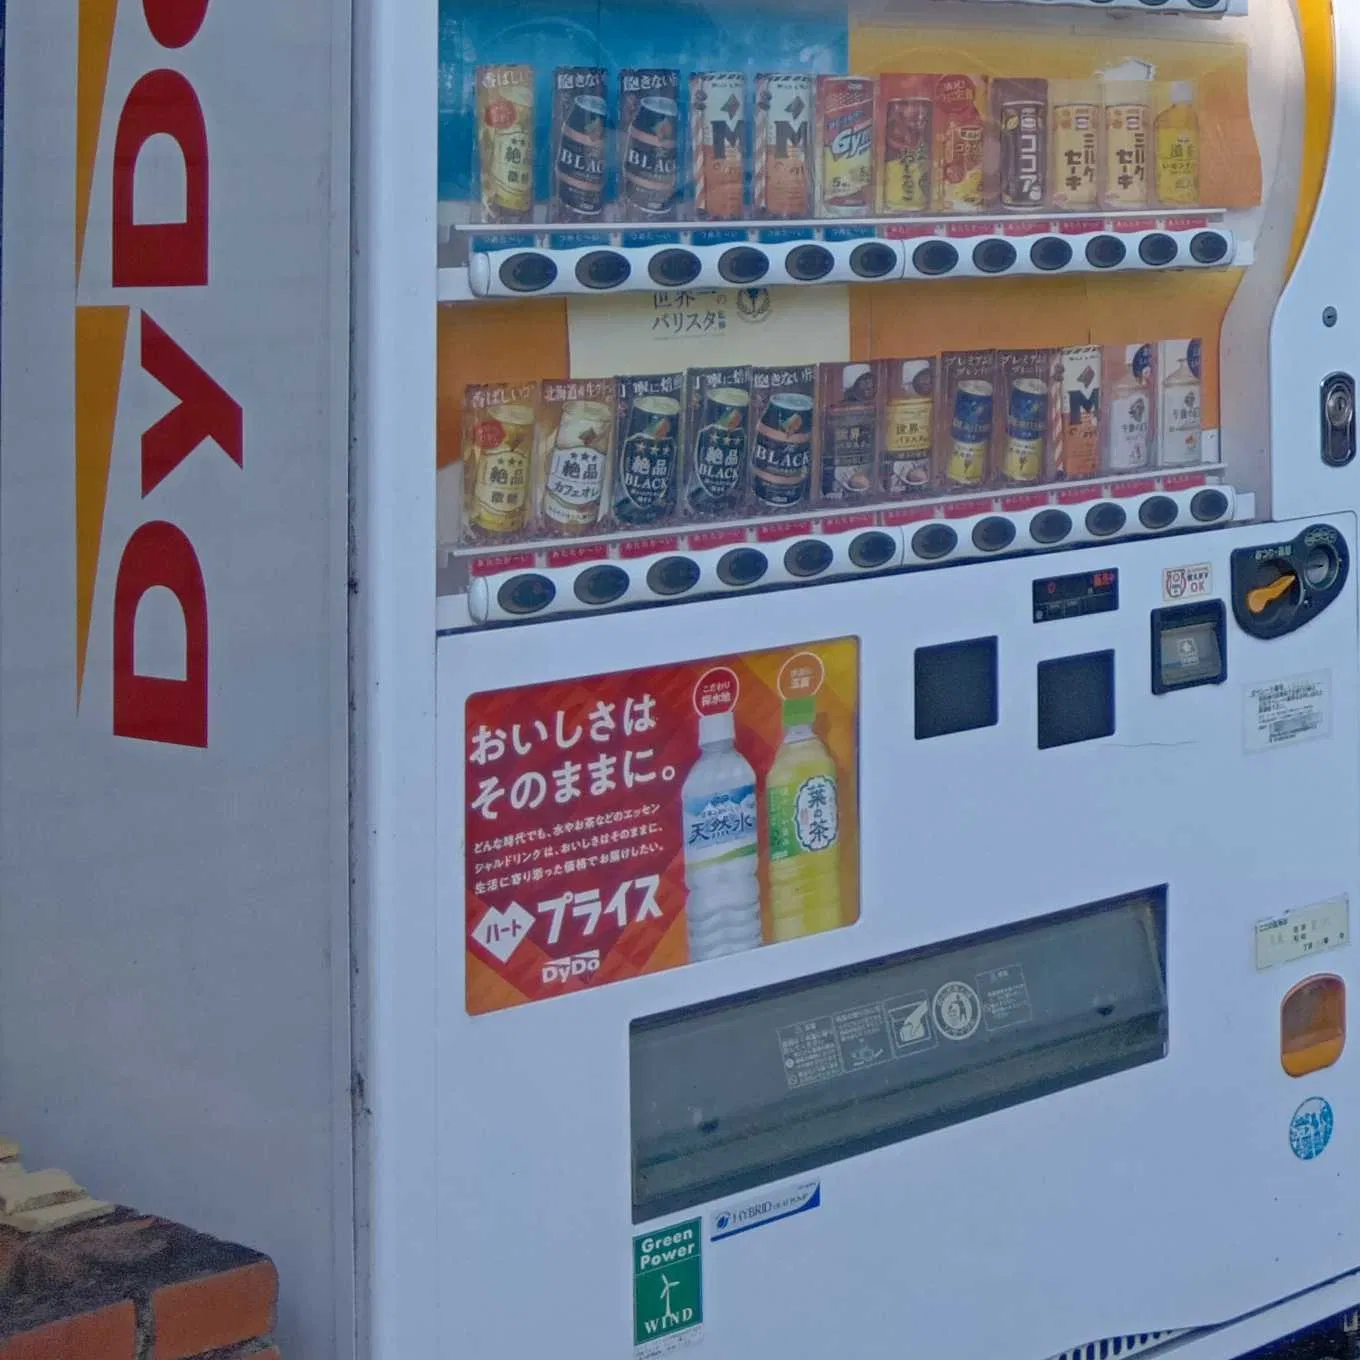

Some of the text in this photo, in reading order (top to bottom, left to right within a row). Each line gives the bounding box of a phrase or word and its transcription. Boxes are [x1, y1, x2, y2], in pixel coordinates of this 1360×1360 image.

[1020, 134, 1036, 192] ココア
[1084, 133, 1096, 183] ミルク
[1134, 132, 1145, 182] ミルク
[563, 461, 598, 480] 絶品
[624, 473, 668, 491] BLACK
[699, 463, 739, 480] BLACK
[470, 693, 658, 766] おいしさは
[471, 747, 676, 821] そのままに。
[688, 811, 754, 846] 天然水
[806, 784, 831, 843] 葉の茶
[538, 874, 664, 945] プライス
[486, 919, 523, 945] ハート
[640, 1243, 695, 1270] Power
[641, 1228, 693, 1253] Green
[644, 1307, 693, 1334] WIND
